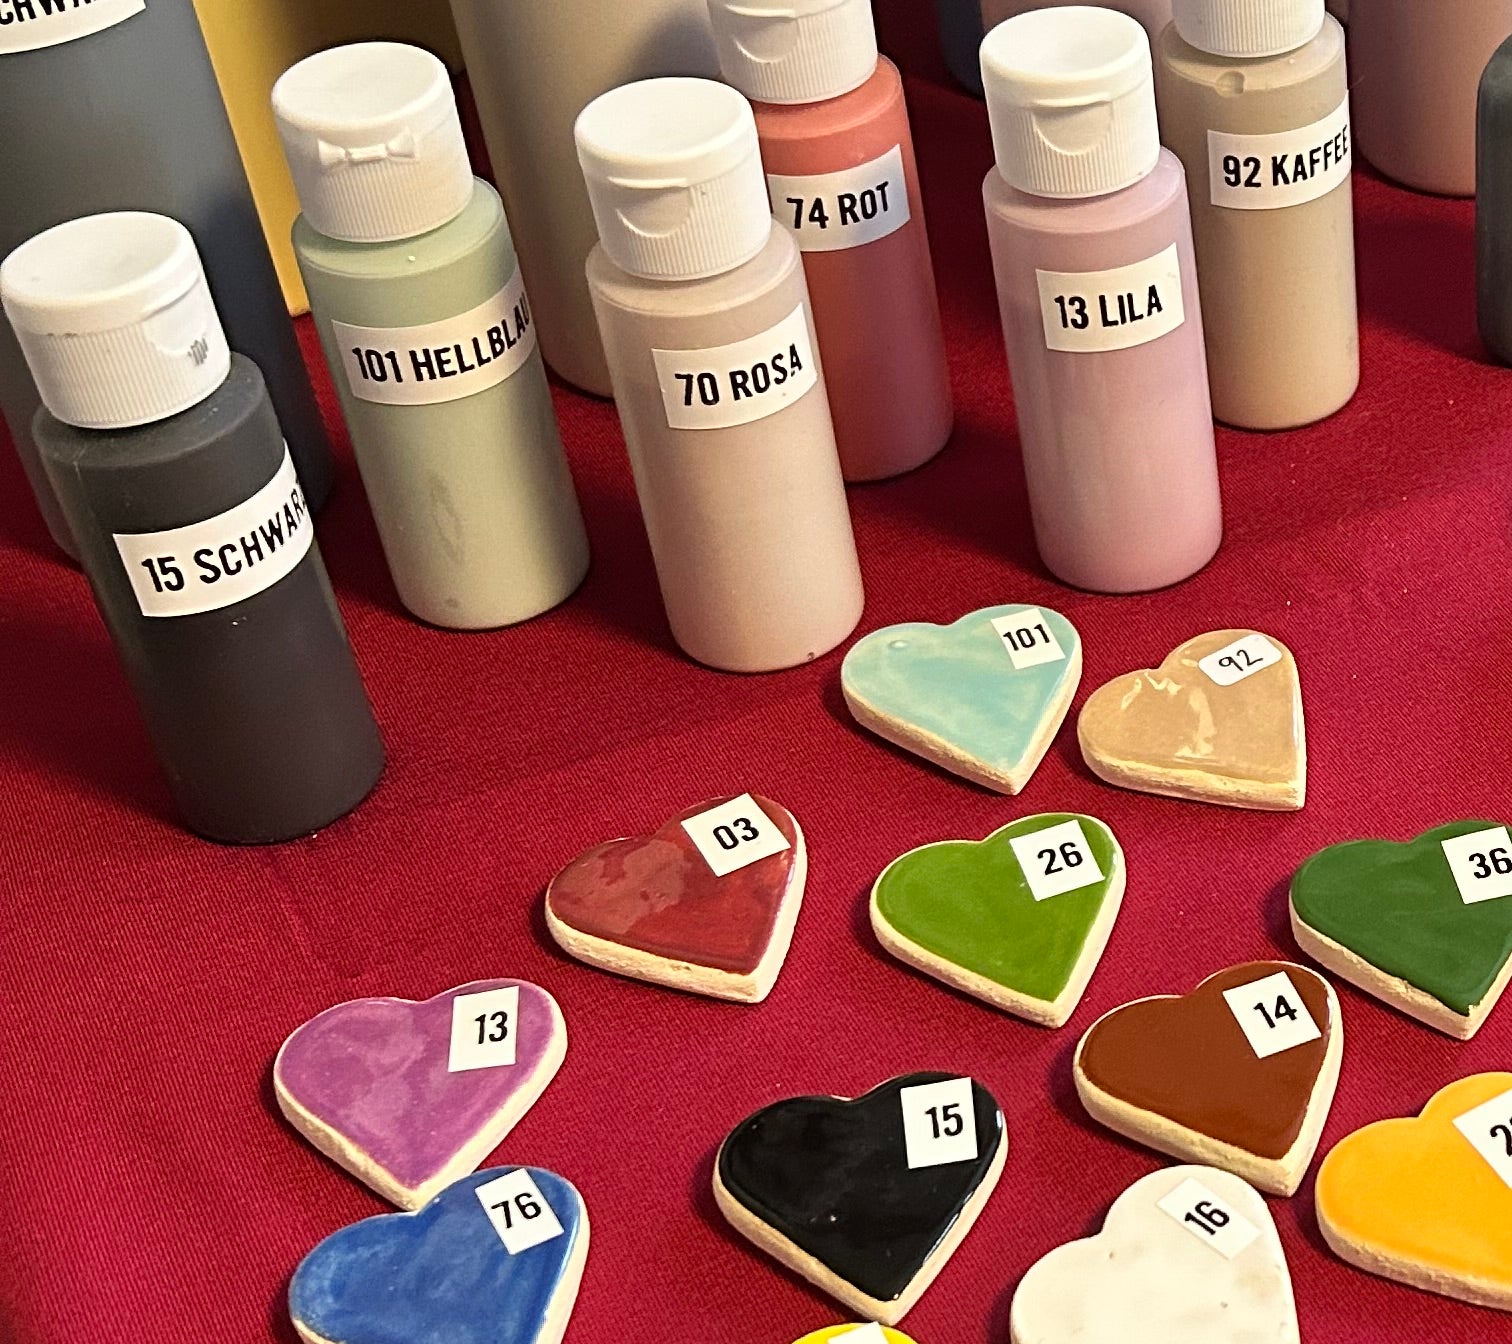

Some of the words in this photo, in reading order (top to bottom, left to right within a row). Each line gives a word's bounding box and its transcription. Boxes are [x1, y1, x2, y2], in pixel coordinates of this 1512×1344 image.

[1223, 155, 1261, 187] 92
[1272, 125, 1347, 186] KAFFEE
[786, 198, 828, 229] 74
[838, 181, 888, 225] ROT
[1054, 296, 1088, 329] 13
[1099, 284, 1163, 328] LILA
[352, 348, 403, 382] 101
[409, 292, 530, 381] HELLBLAU
[675, 373, 719, 406] 70
[731, 344, 803, 400] ROSA
[141, 557, 184, 592] 15
[193, 488, 307, 584] SCHWAR
[1003, 624, 1049, 650] 101
[1218, 649, 1264, 673] 92
[713, 818, 759, 850] 03
[1038, 842, 1083, 875] 26
[475, 1011, 507, 1044] 13
[1254, 994, 1298, 1029] 14
[925, 1103, 963, 1138] 15
[491, 1192, 543, 1229] 76
[1185, 1201, 1229, 1235] 16
